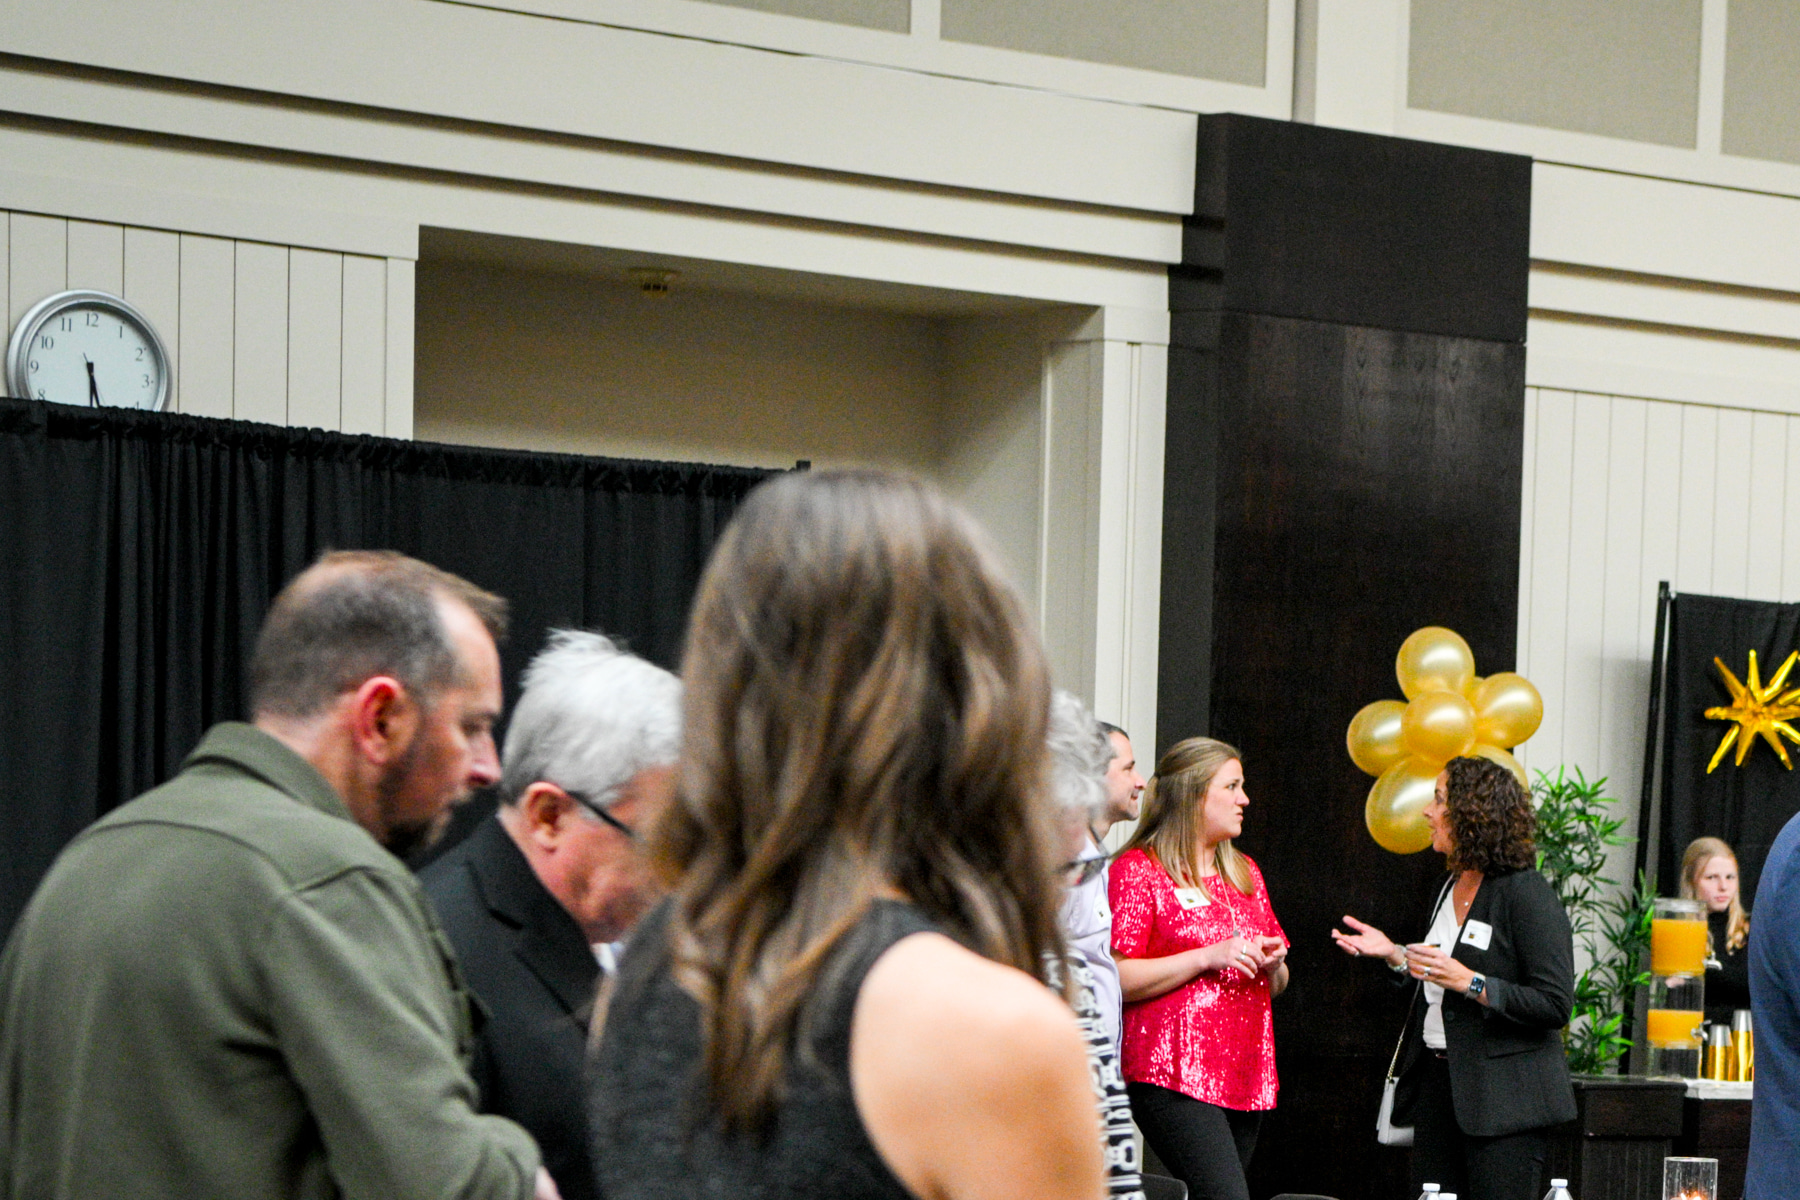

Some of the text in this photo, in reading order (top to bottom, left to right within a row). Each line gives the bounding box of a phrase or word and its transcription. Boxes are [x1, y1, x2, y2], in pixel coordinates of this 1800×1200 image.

[61, 317, 72, 332] 11
[86, 312, 99, 328] 12
[41, 335, 54, 350] 10
[135, 348, 144, 362] 2
[30, 361, 40, 374] 9
[142, 374, 150, 388] 3
